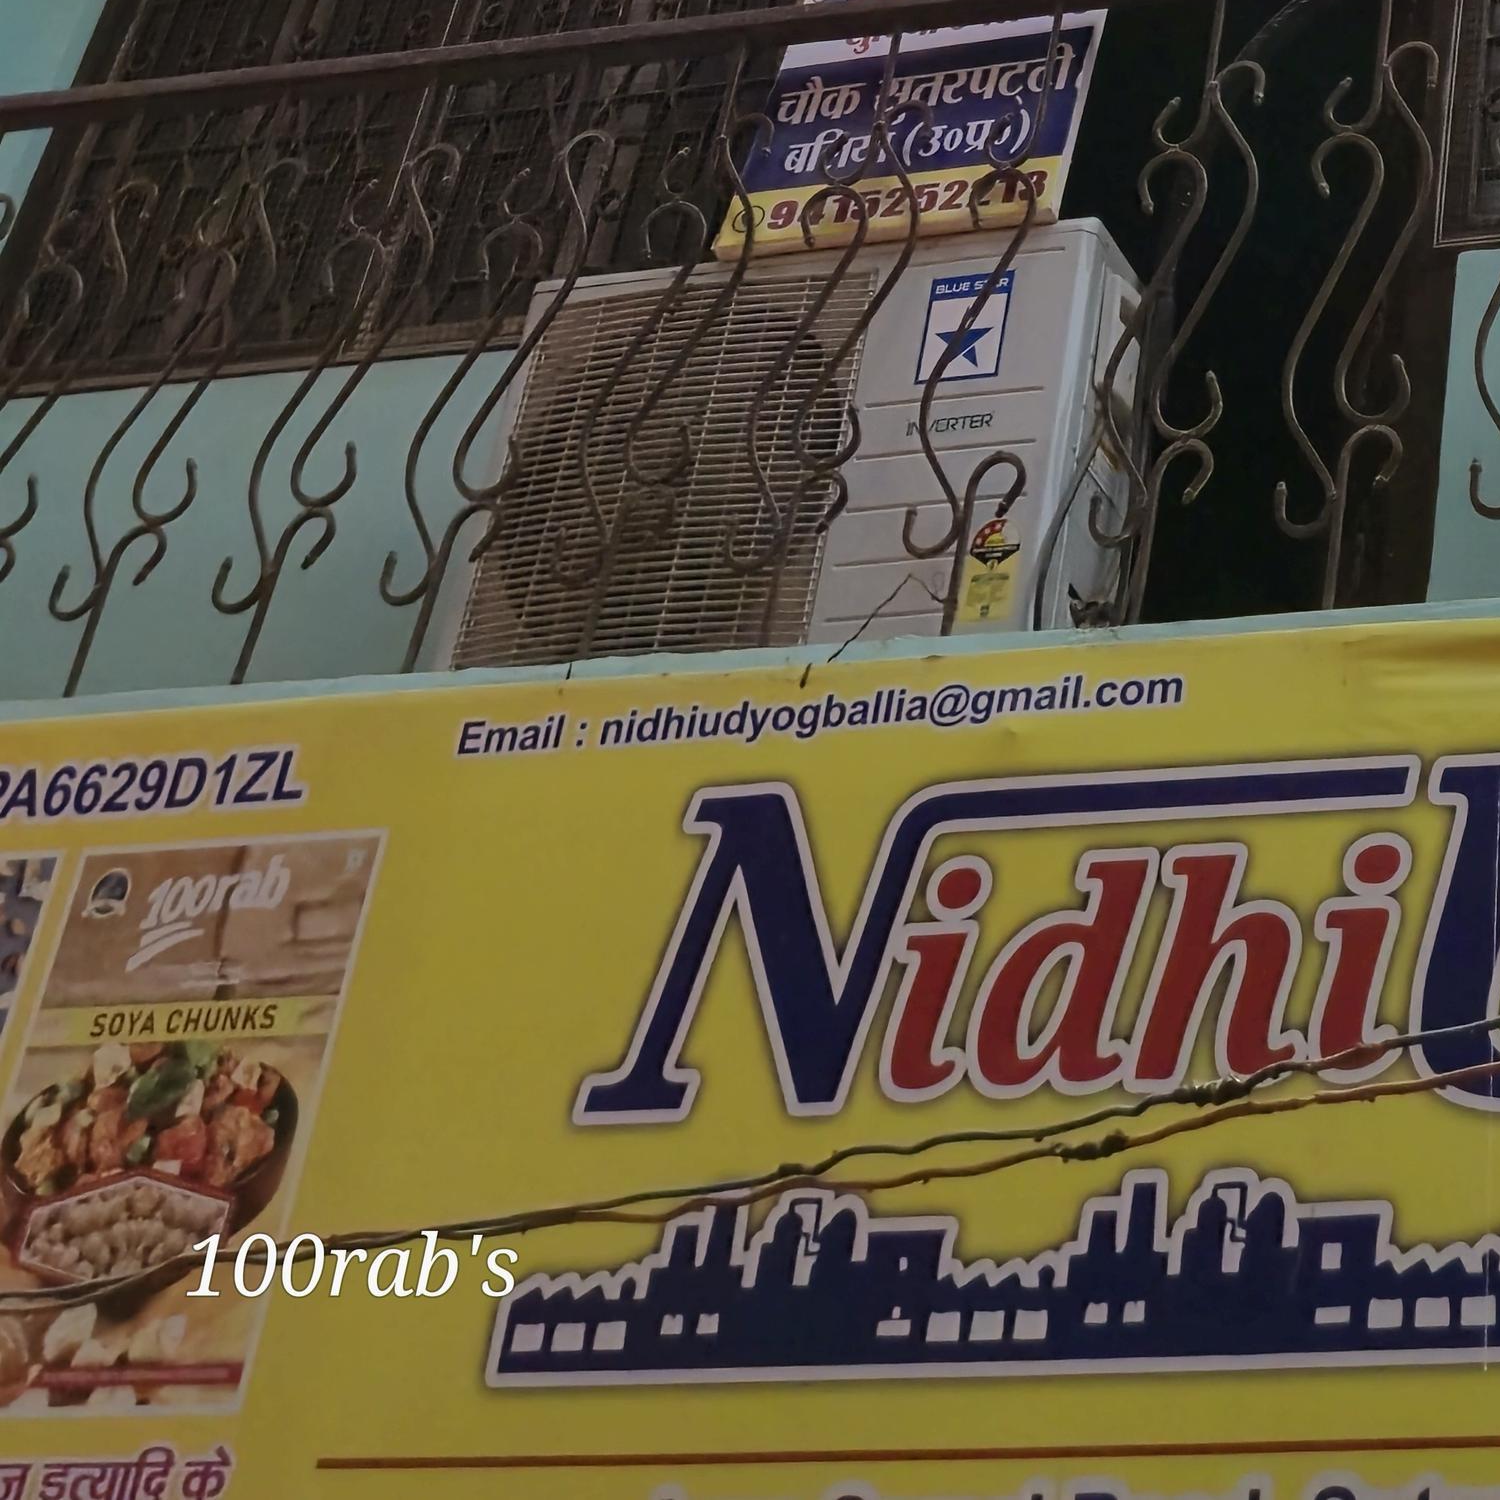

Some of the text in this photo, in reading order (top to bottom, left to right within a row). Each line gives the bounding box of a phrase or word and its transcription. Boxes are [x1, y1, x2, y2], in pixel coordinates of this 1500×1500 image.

[777, 75, 867, 126] चौक
[767, 169, 1050, 231] 941525213
[935, 277, 1010, 295] BLUE SR
[456, 716, 563, 755] Email
[599, 674, 1184, 747] nidhiudyogballia@gmail.com
[139, 853, 291, 932] 100rab
[89, 1003, 279, 1038] SOYA CHUNKS
